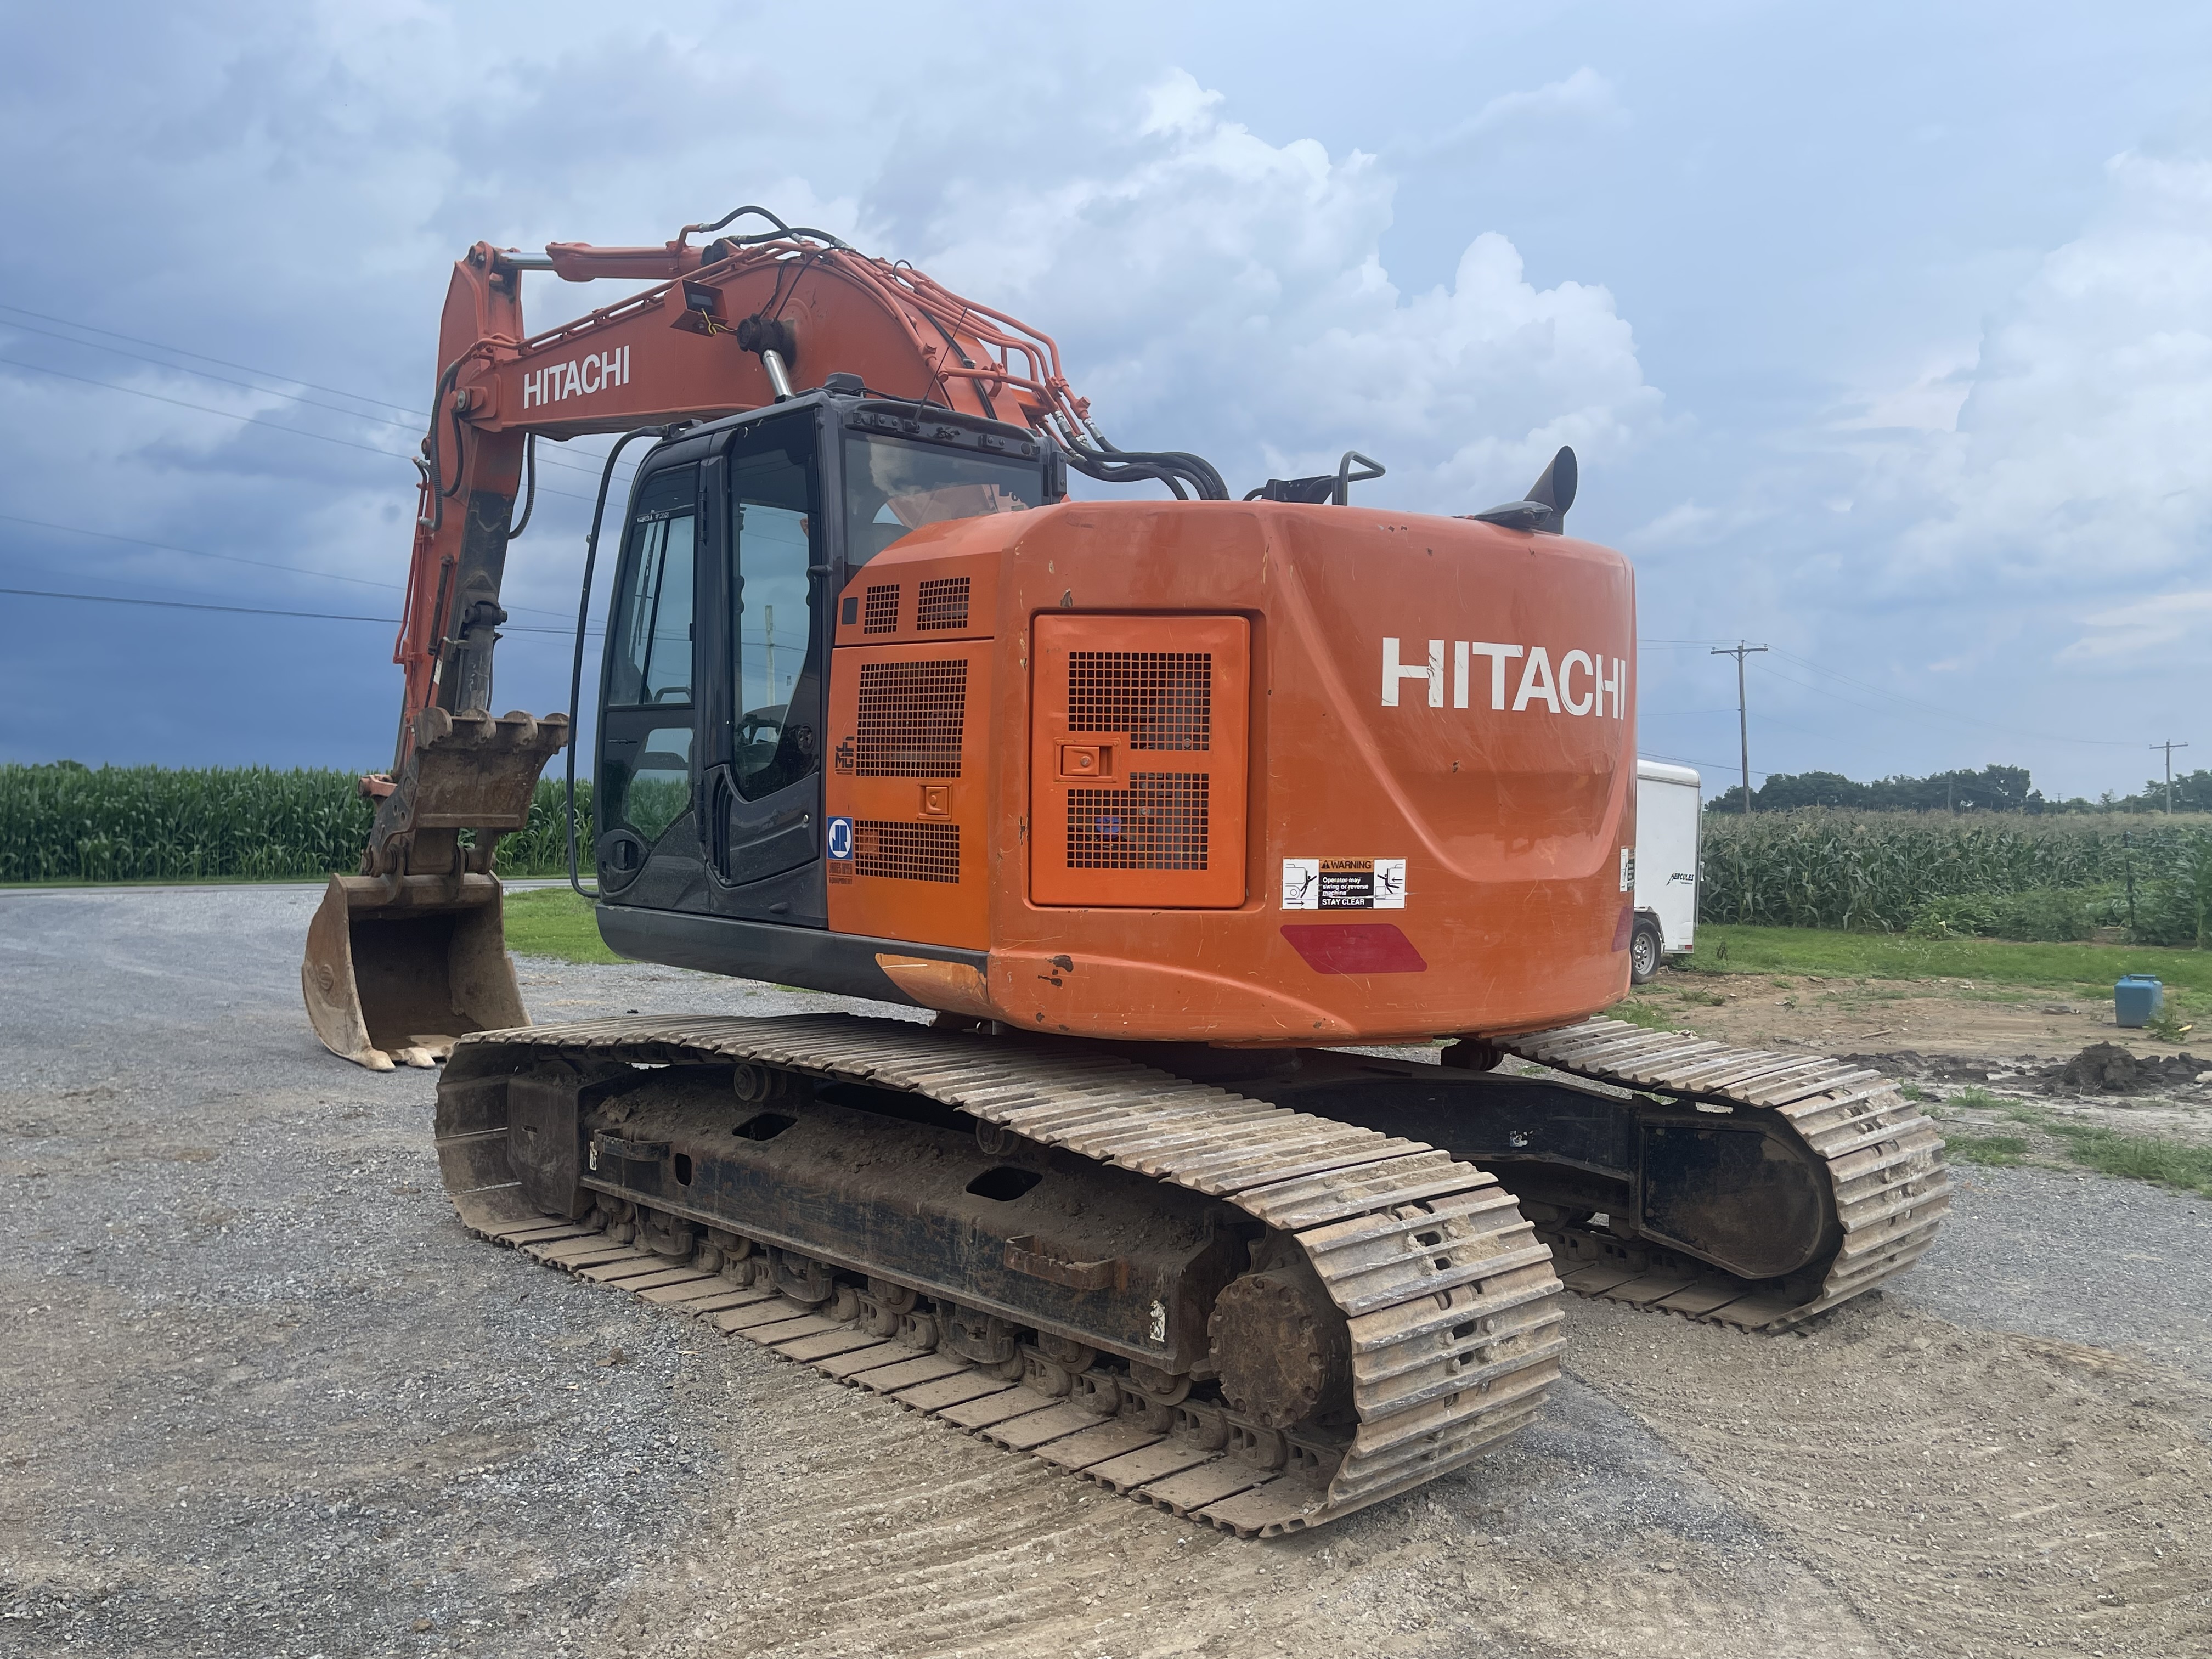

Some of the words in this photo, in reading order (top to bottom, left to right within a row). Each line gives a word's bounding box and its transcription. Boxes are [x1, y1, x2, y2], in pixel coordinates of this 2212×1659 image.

[524, 345, 629, 409] HITACHI
[1381, 637, 1626, 720] HITACHI
[1331, 861, 1372, 869] WARNING
[1666, 872, 1695, 885] HERCULES
